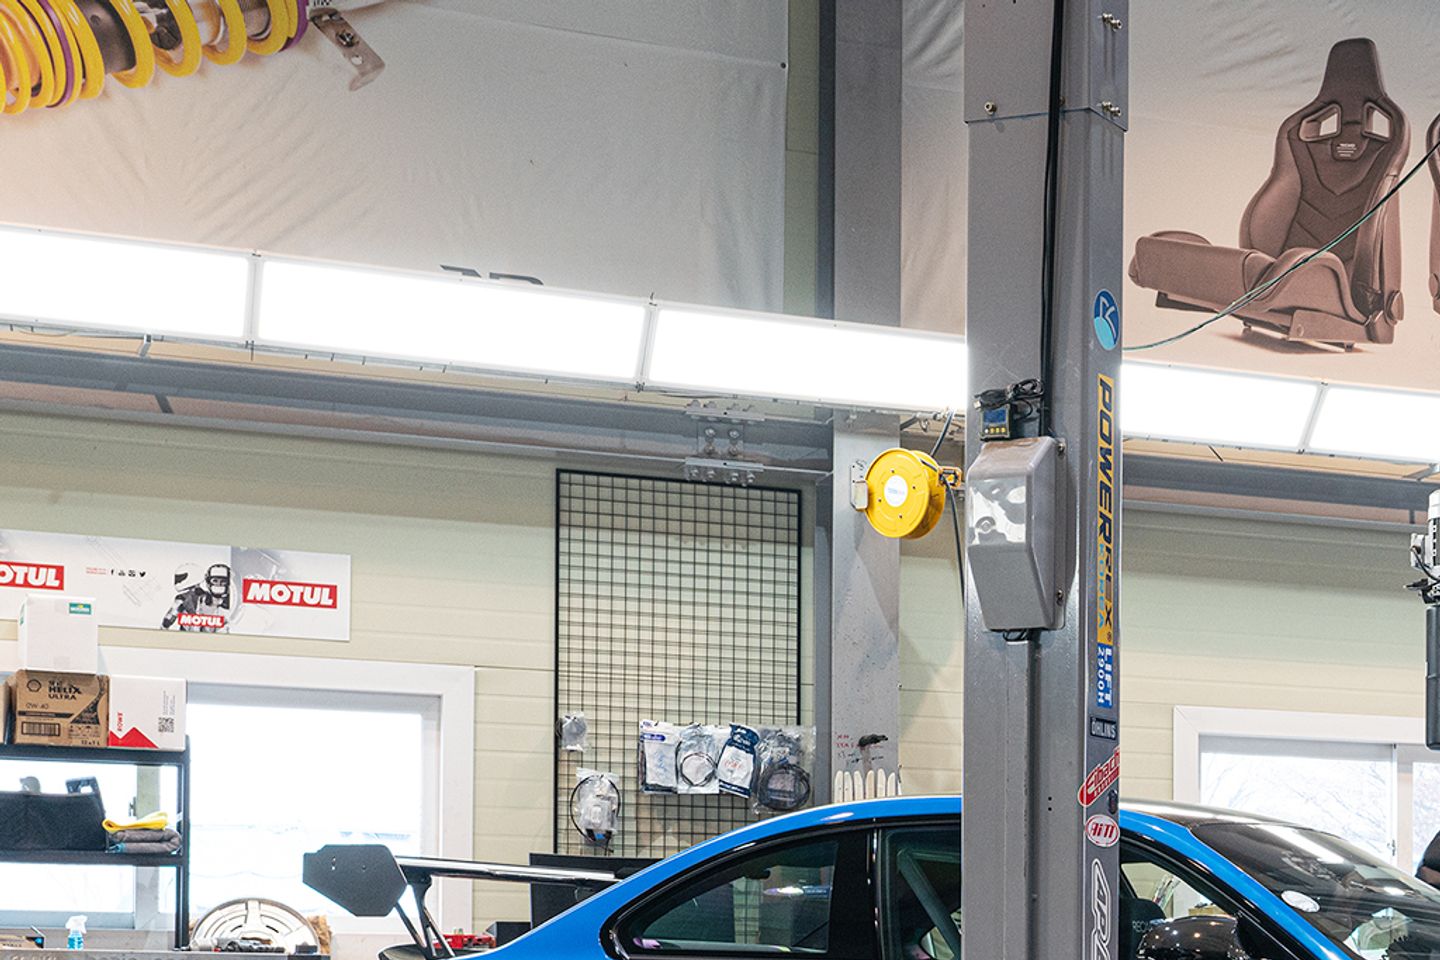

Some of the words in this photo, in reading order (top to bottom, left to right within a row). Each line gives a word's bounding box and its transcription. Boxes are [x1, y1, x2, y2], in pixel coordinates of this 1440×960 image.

[0, 564, 60, 587] OTUL
[247, 582, 334, 606] MOTUL
[179, 614, 223, 627] MOTUL
